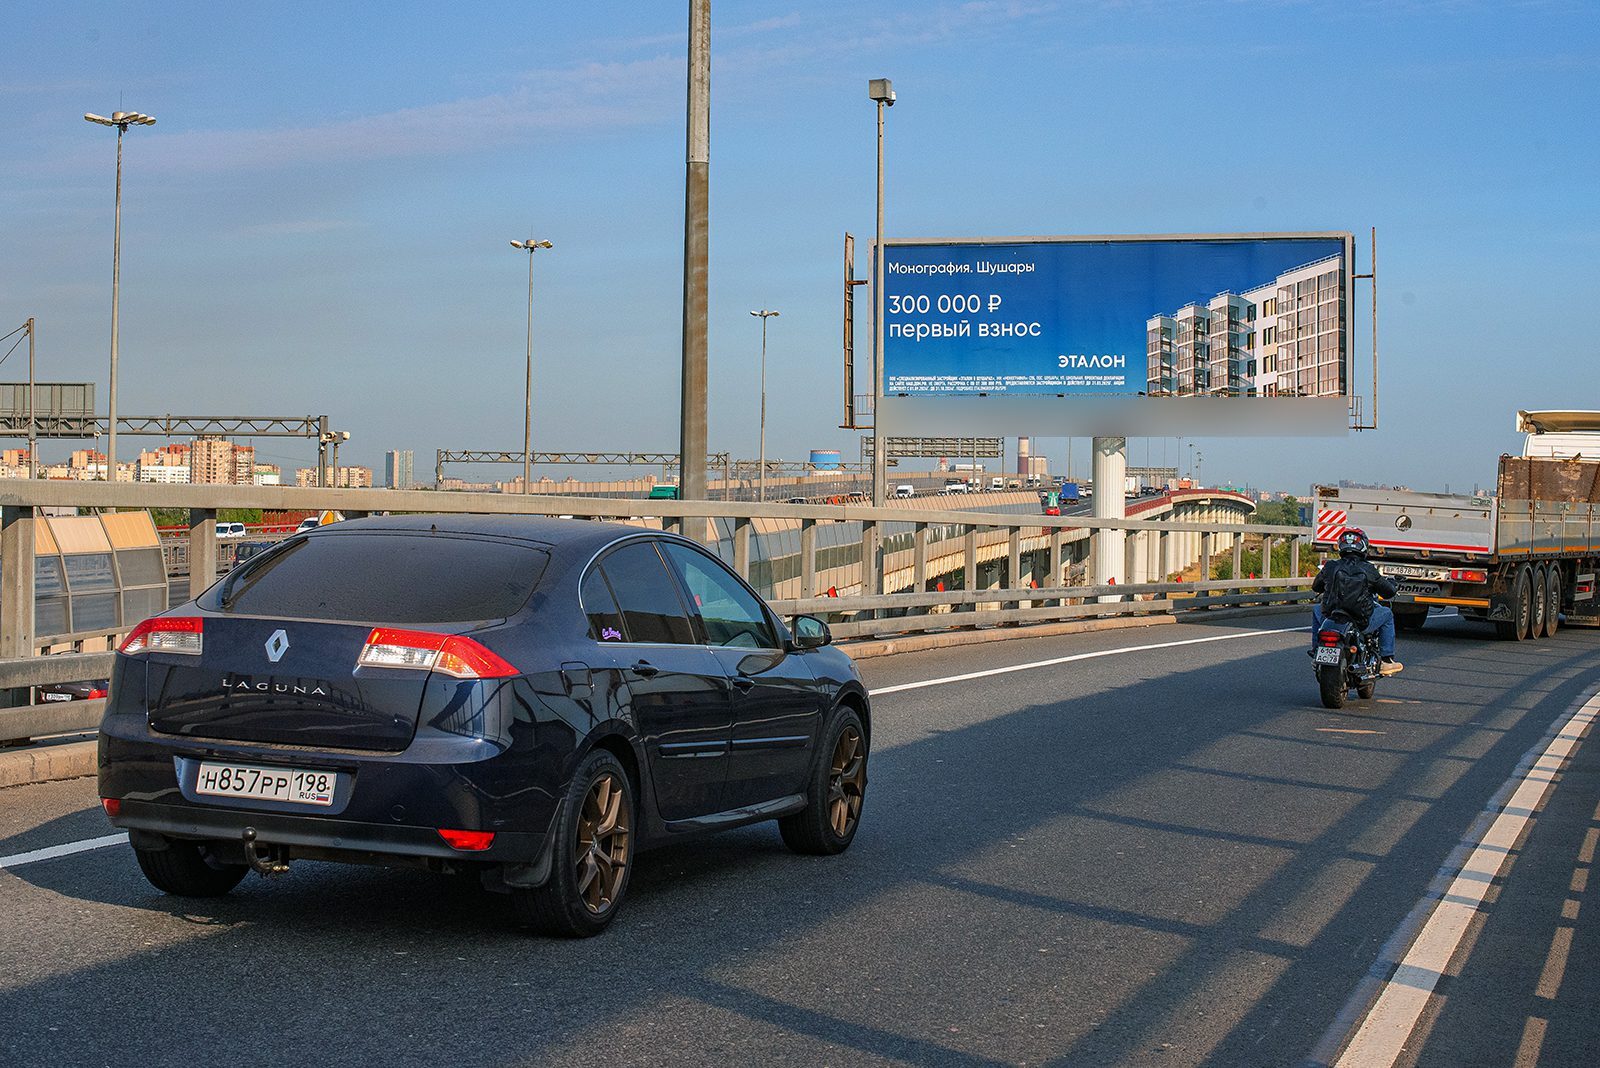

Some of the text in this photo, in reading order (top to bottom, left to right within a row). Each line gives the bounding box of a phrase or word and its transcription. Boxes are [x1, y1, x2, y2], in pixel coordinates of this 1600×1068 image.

[888, 261, 1035, 276] Монография. Шушары
[889, 294, 1002, 314] 300 000 ₽
[889, 320, 1041, 342] первый взнос
[1058, 354, 1125, 368] ЭТАЛОН
[222, 679, 326, 696] LAGUNA
[205, 768, 328, 796] Н857РР 198
[299, 791, 317, 801] RUS
